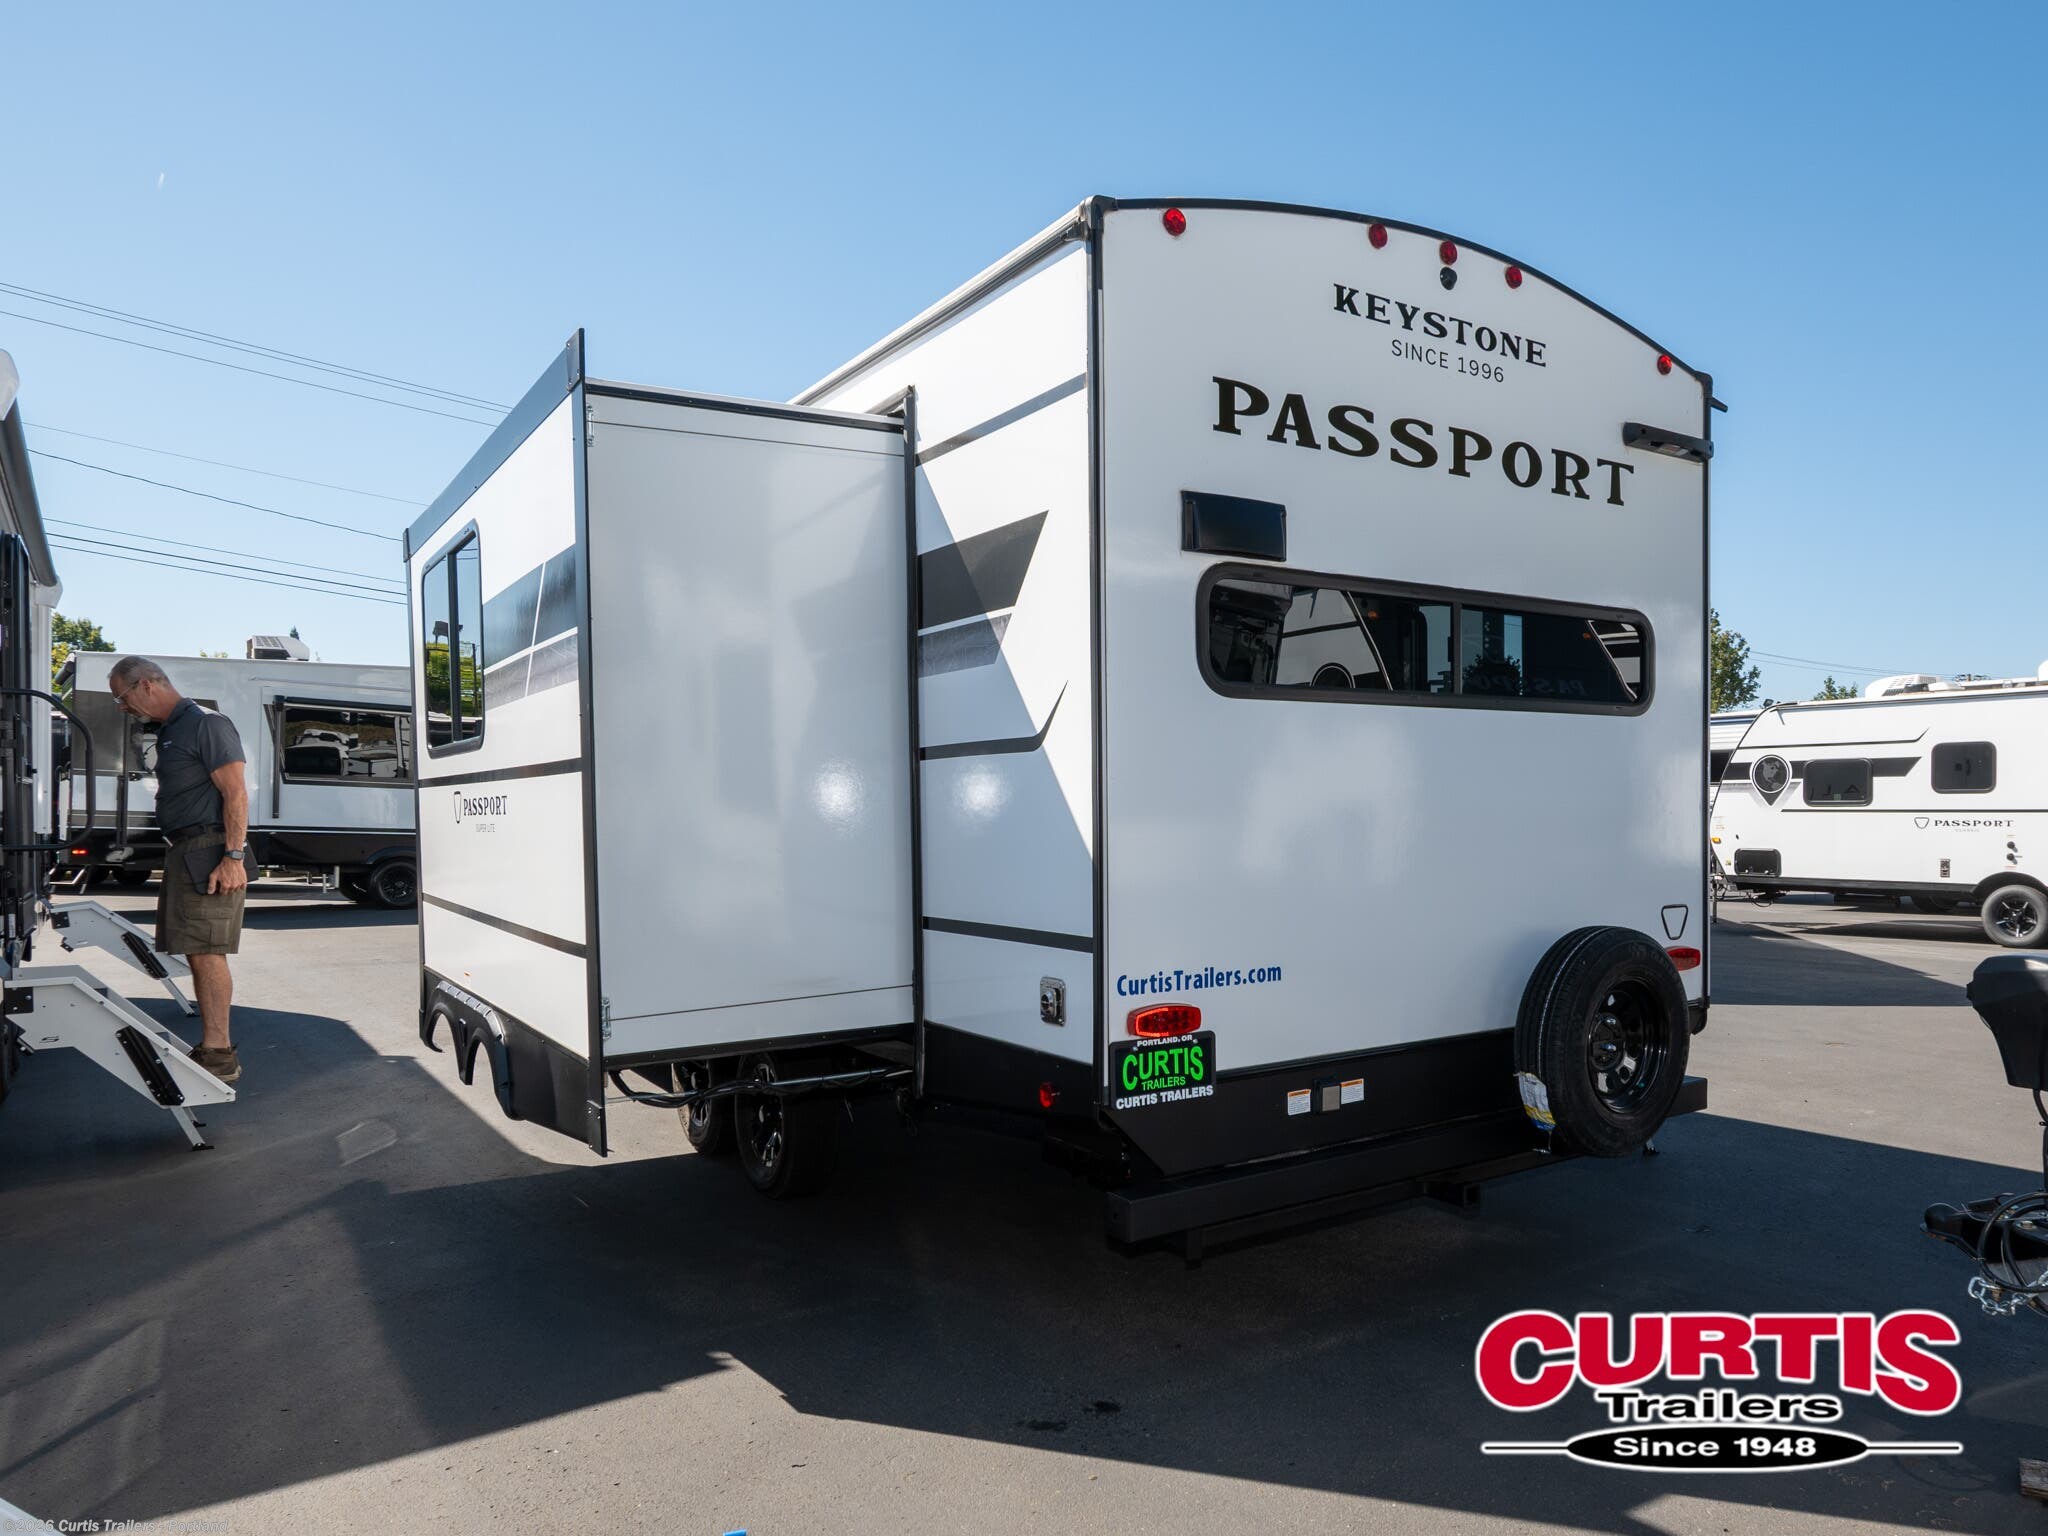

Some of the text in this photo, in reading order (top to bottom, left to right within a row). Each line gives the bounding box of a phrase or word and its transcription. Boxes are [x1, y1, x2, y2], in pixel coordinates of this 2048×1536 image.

[1333, 283, 1547, 368] KEYSTONE
[1391, 339, 1505, 383] SINCE 1996
[1212, 376, 1635, 507] PASSPORT
[463, 795, 508, 816] PASSPORT
[1934, 819, 2014, 827] PASSPORT
[1117, 966, 1281, 996] CurtisTrailers.com
[1122, 1045, 1204, 1091] CURTIS
[1115, 1084, 1214, 1110] CURTIS TRAILERS
[1141, 1076, 1186, 1091] TRAILERS
